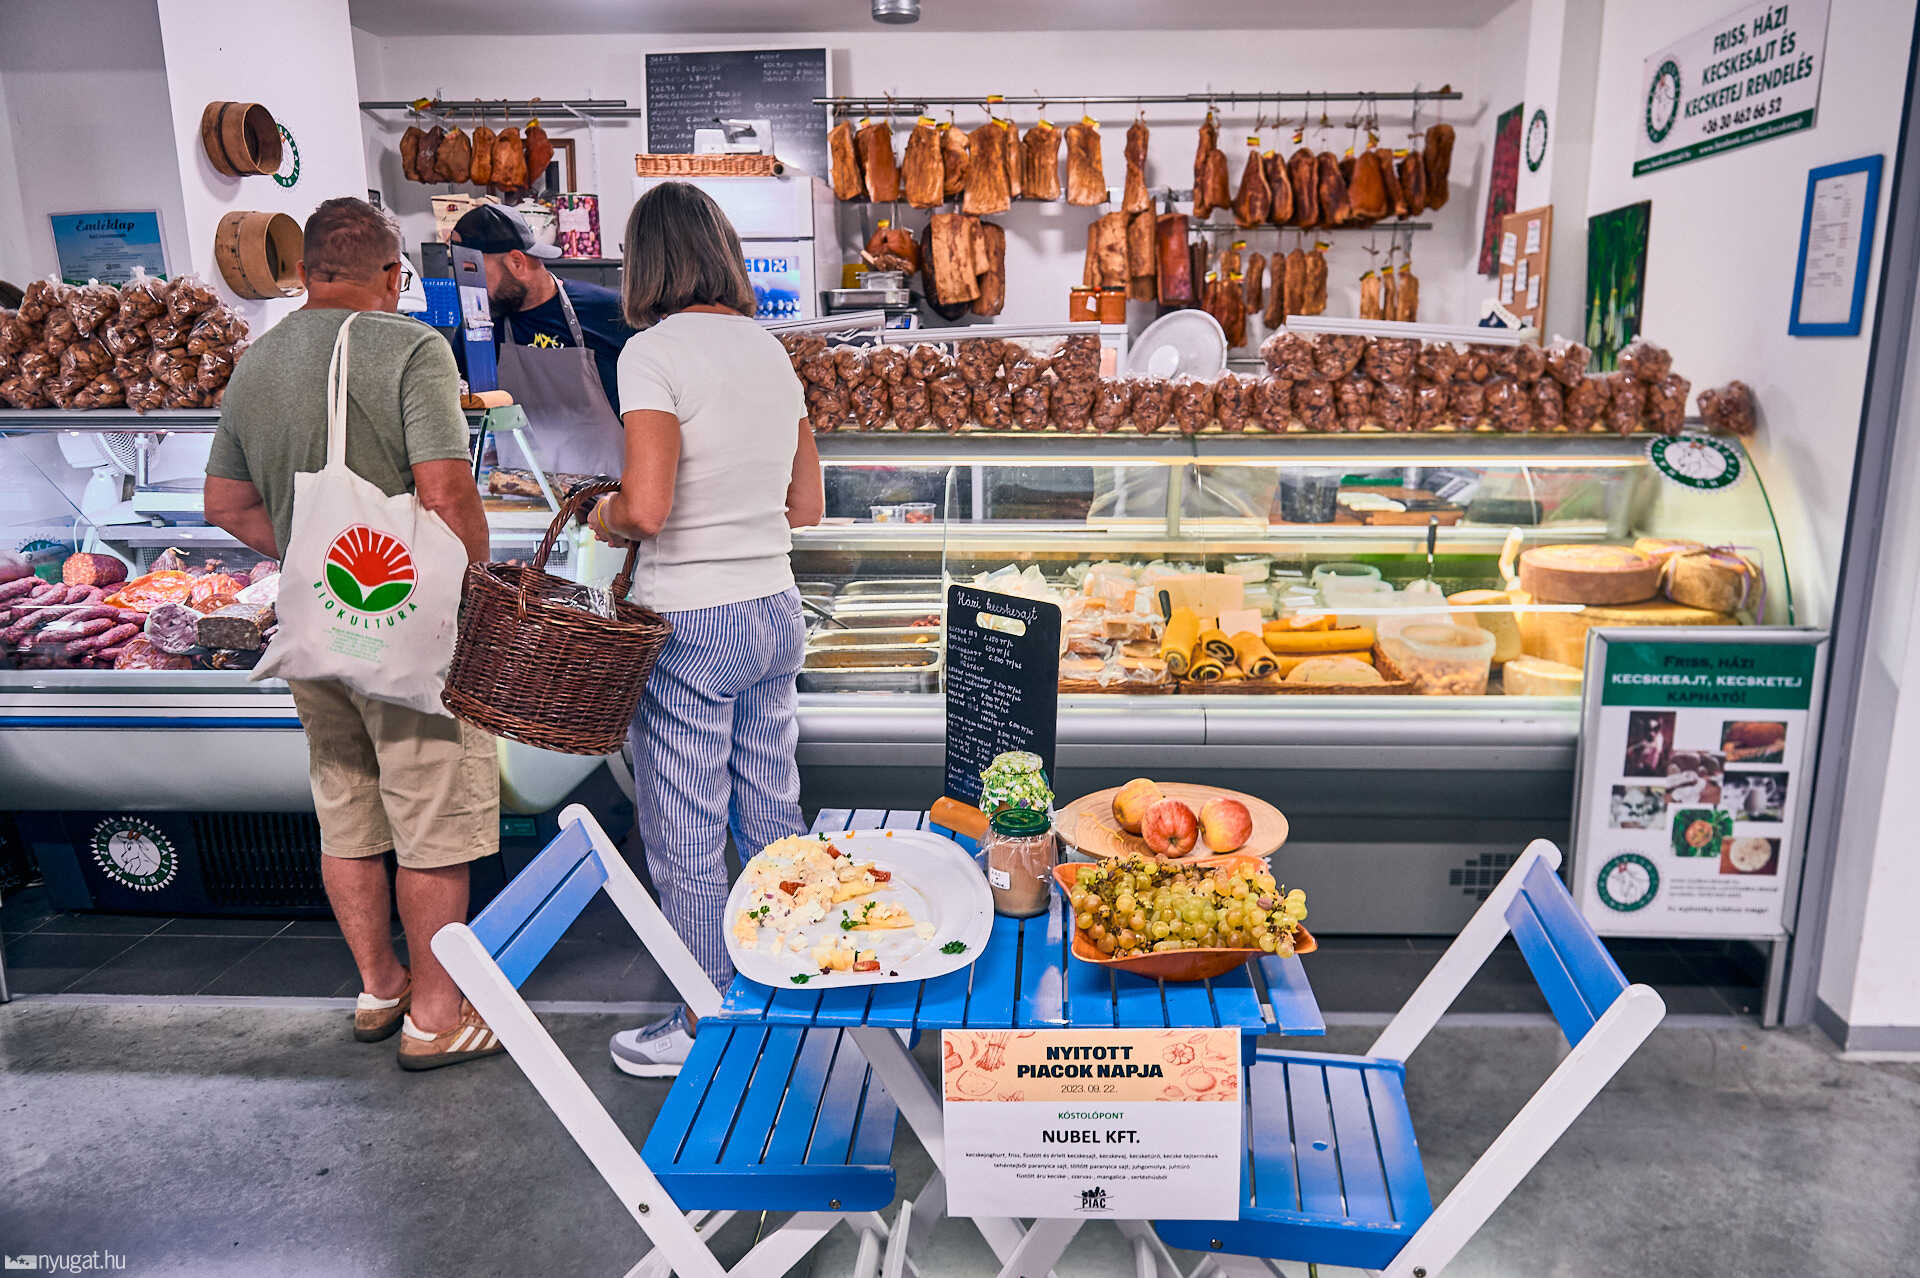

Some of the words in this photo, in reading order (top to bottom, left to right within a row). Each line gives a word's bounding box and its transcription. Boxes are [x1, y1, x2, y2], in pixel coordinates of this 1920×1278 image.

[1713, 24, 1748, 54] FRISS,
[1753, 5, 1788, 37] HÁZI
[1702, 39, 1778, 86] KECSKESAJT
[1780, 28, 1796, 57] ÉS
[1684, 81, 1743, 119] KECSKETEJ
[1746, 51, 1814, 97] RENDELÉS
[1753, 104, 1766, 120] 66
[313, 580, 418, 630] BIOKULTURA
[1718, 656, 1755, 669] HÁZI
[1612, 674, 1712, 687] KECSKESAJT,
[1716, 676, 1802, 688] KECSKETEJ
[1046, 1046, 1134, 1061] NYITOTT
[1017, 1064, 1094, 1079] PIACOK
[1097, 1064, 1164, 1079] NAPJA
[1061, 1084, 1085, 1094] 2023.
[1103, 1084, 1119, 1094] 22.
[1057, 1110, 1124, 1120] KÓSTOLÓPONT
[1042, 1130, 1101, 1144] NUBEL
[1106, 1130, 1140, 1144] KFT.
[1082, 1197, 1106, 1208] PIAC
